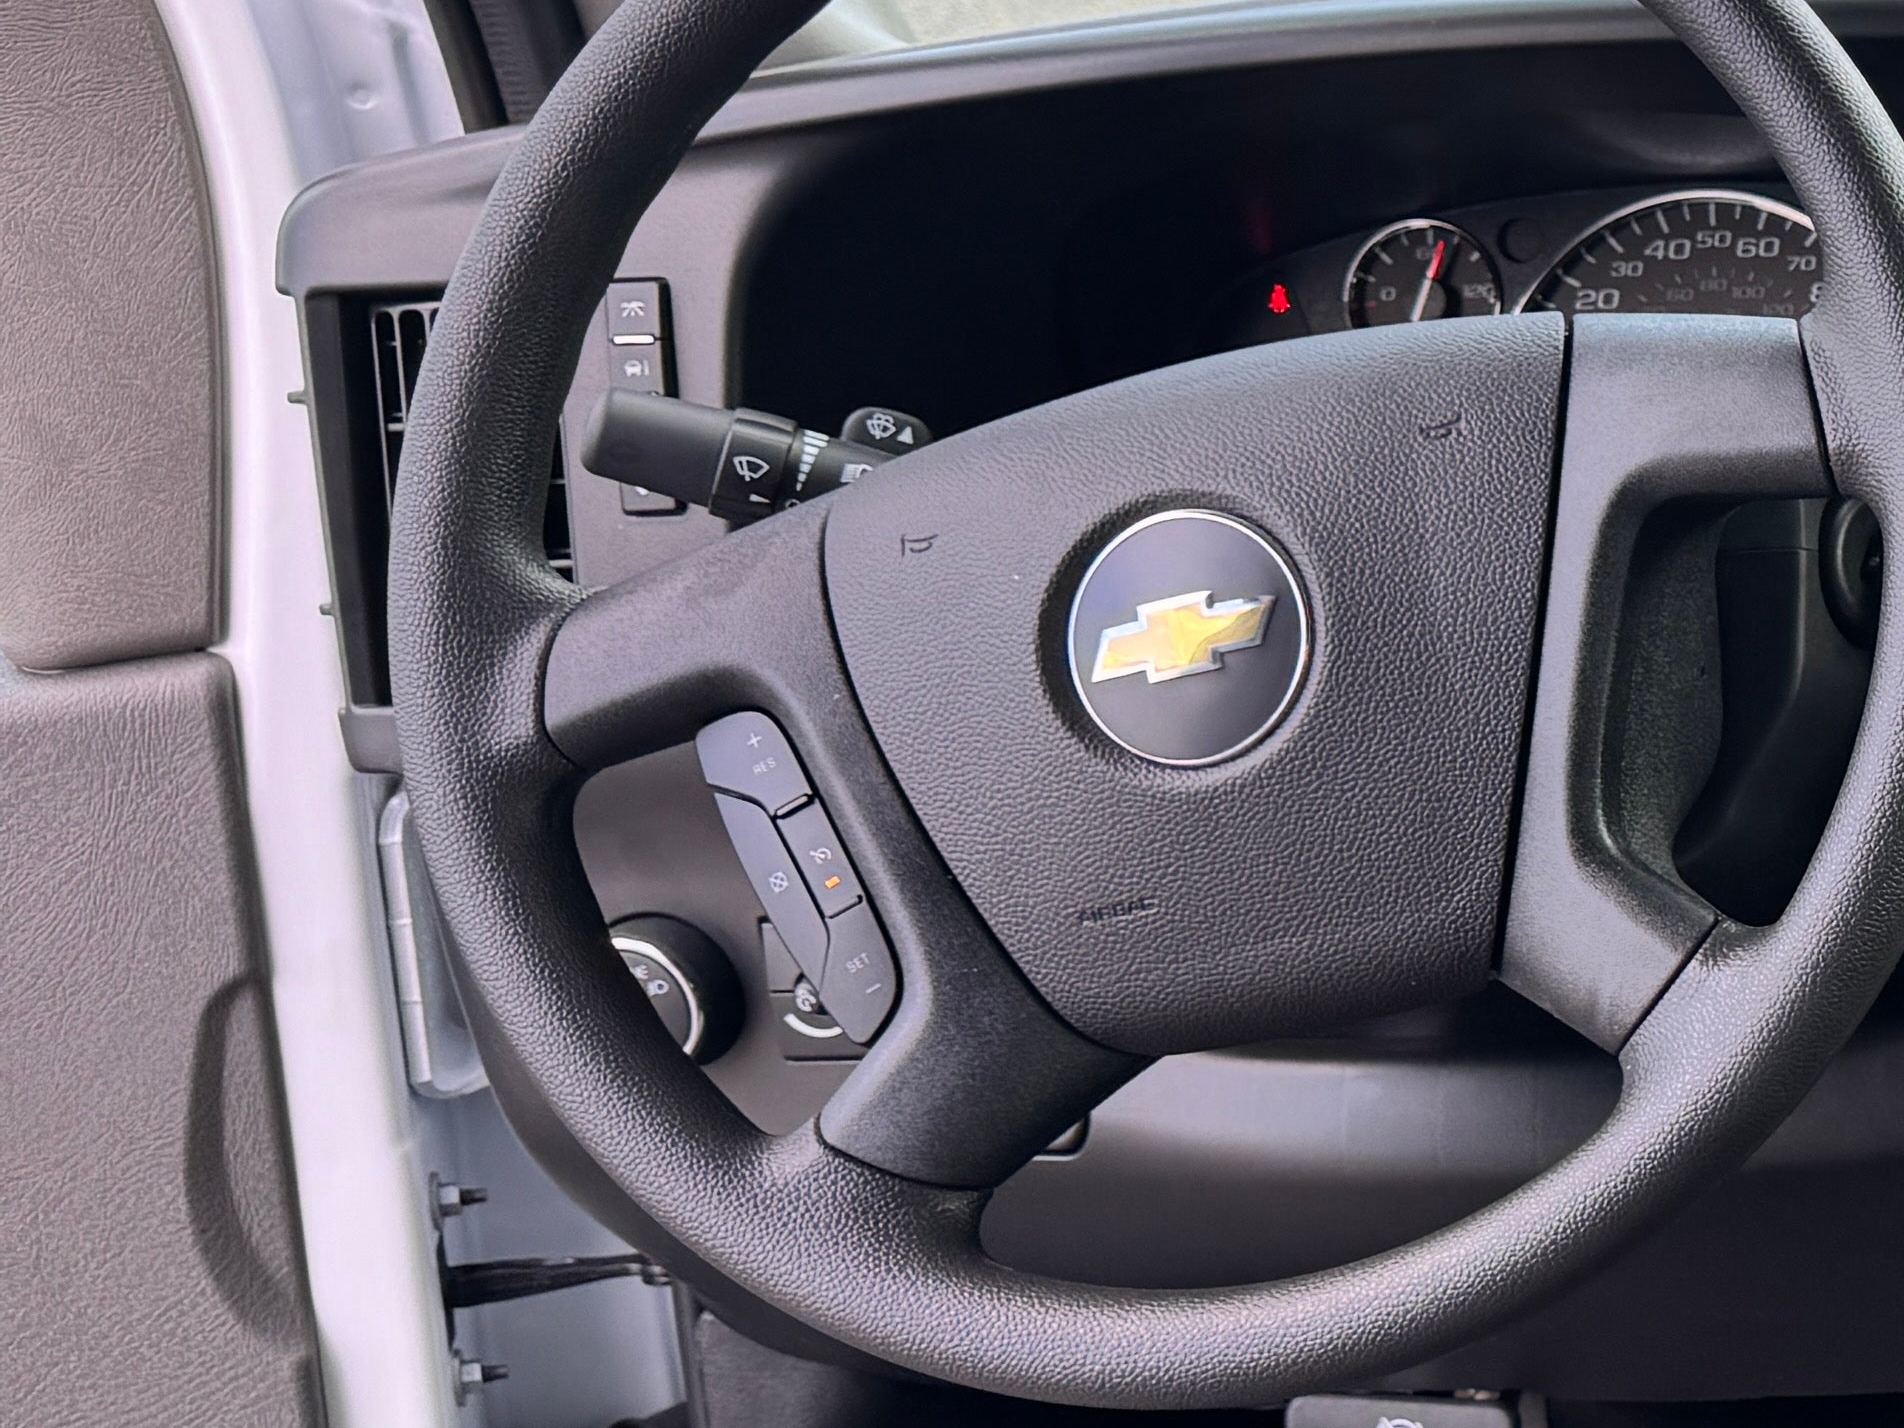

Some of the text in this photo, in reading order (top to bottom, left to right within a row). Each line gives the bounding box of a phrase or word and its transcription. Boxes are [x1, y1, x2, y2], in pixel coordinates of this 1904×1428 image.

[1643, 238, 1692, 260] 40
[1695, 229, 1733, 249] 50
[1736, 236, 1780, 258] 60
[1610, 260, 1644, 278] 30
[1786, 255, 1817, 272] 70
[1378, 286, 1397, 302] 0
[1574, 288, 1621, 311] 20
[752, 757, 777, 775] RES
[846, 952, 871, 974] SET
